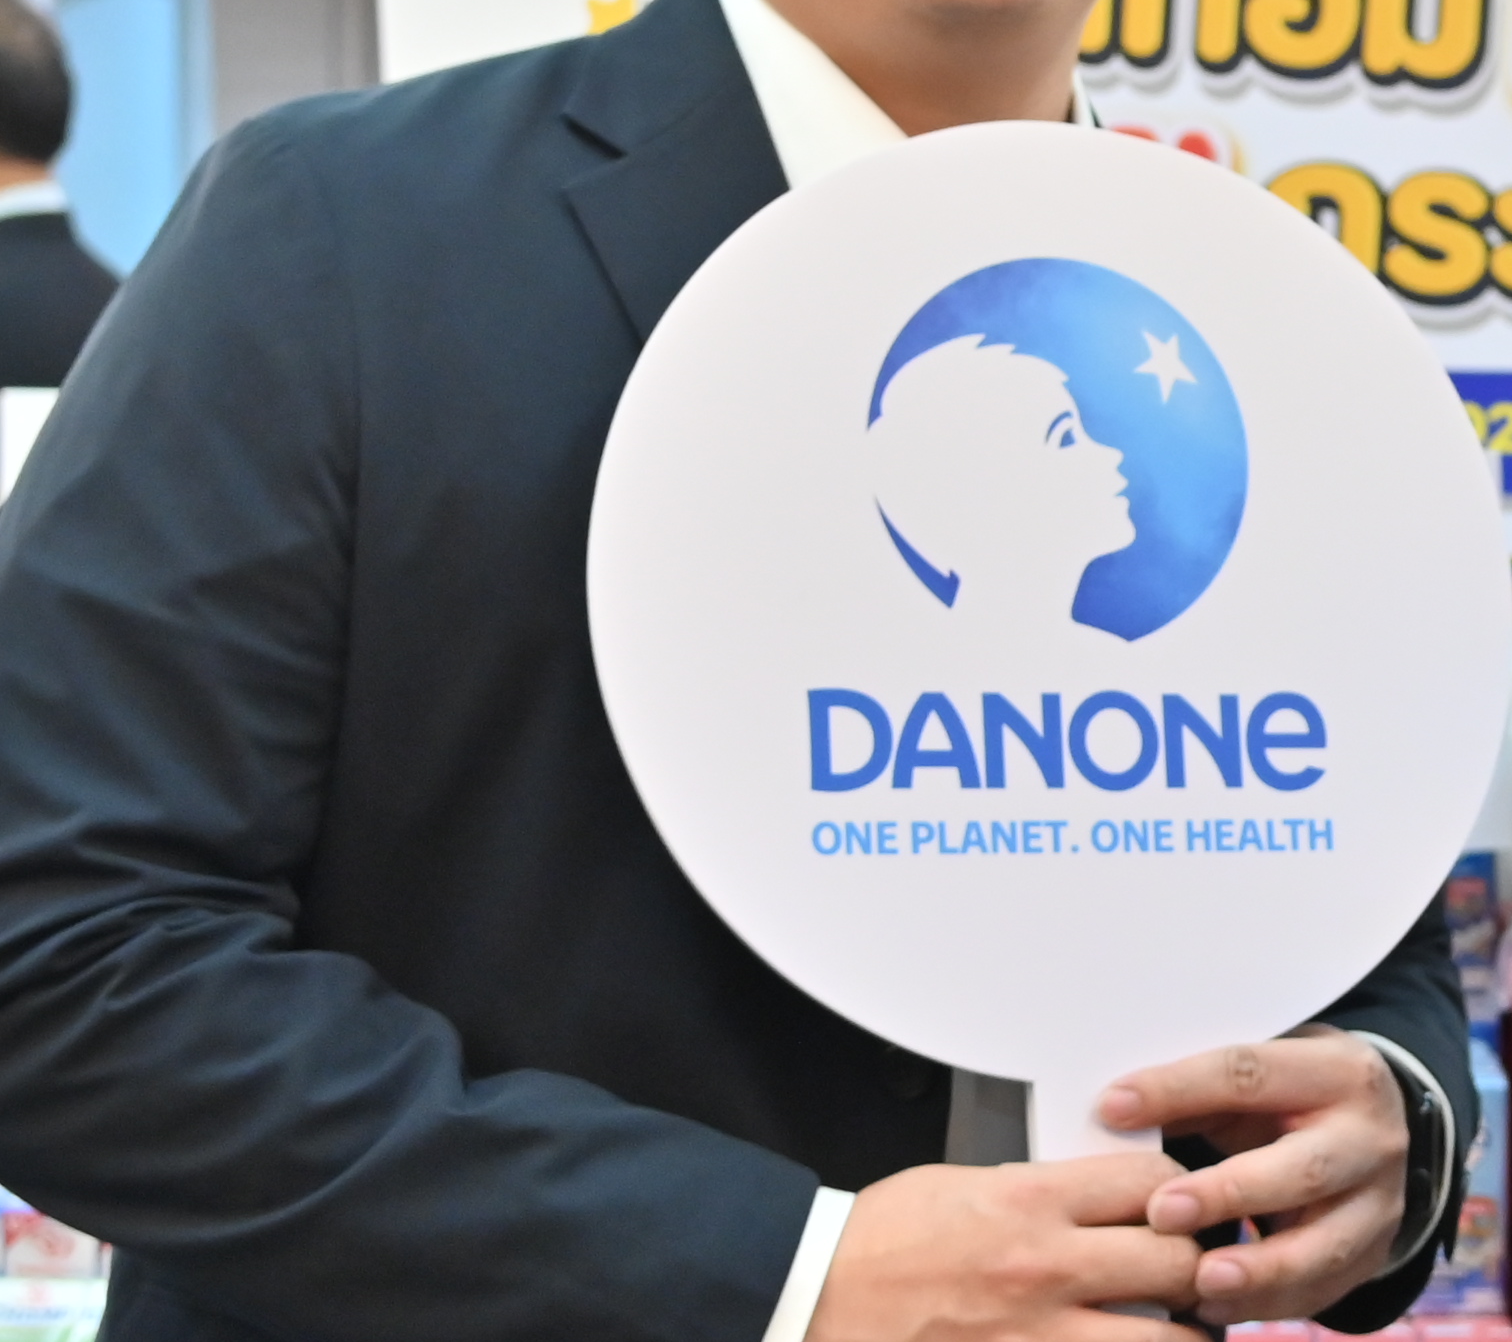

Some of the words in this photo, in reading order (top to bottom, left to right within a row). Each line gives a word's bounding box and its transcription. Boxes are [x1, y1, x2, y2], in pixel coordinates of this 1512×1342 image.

[811, 819, 901, 857] ONE
[910, 819, 1081, 856] PLANET.
[1090, 818, 1177, 854] ONE
[1185, 817, 1336, 854] HEALTH
